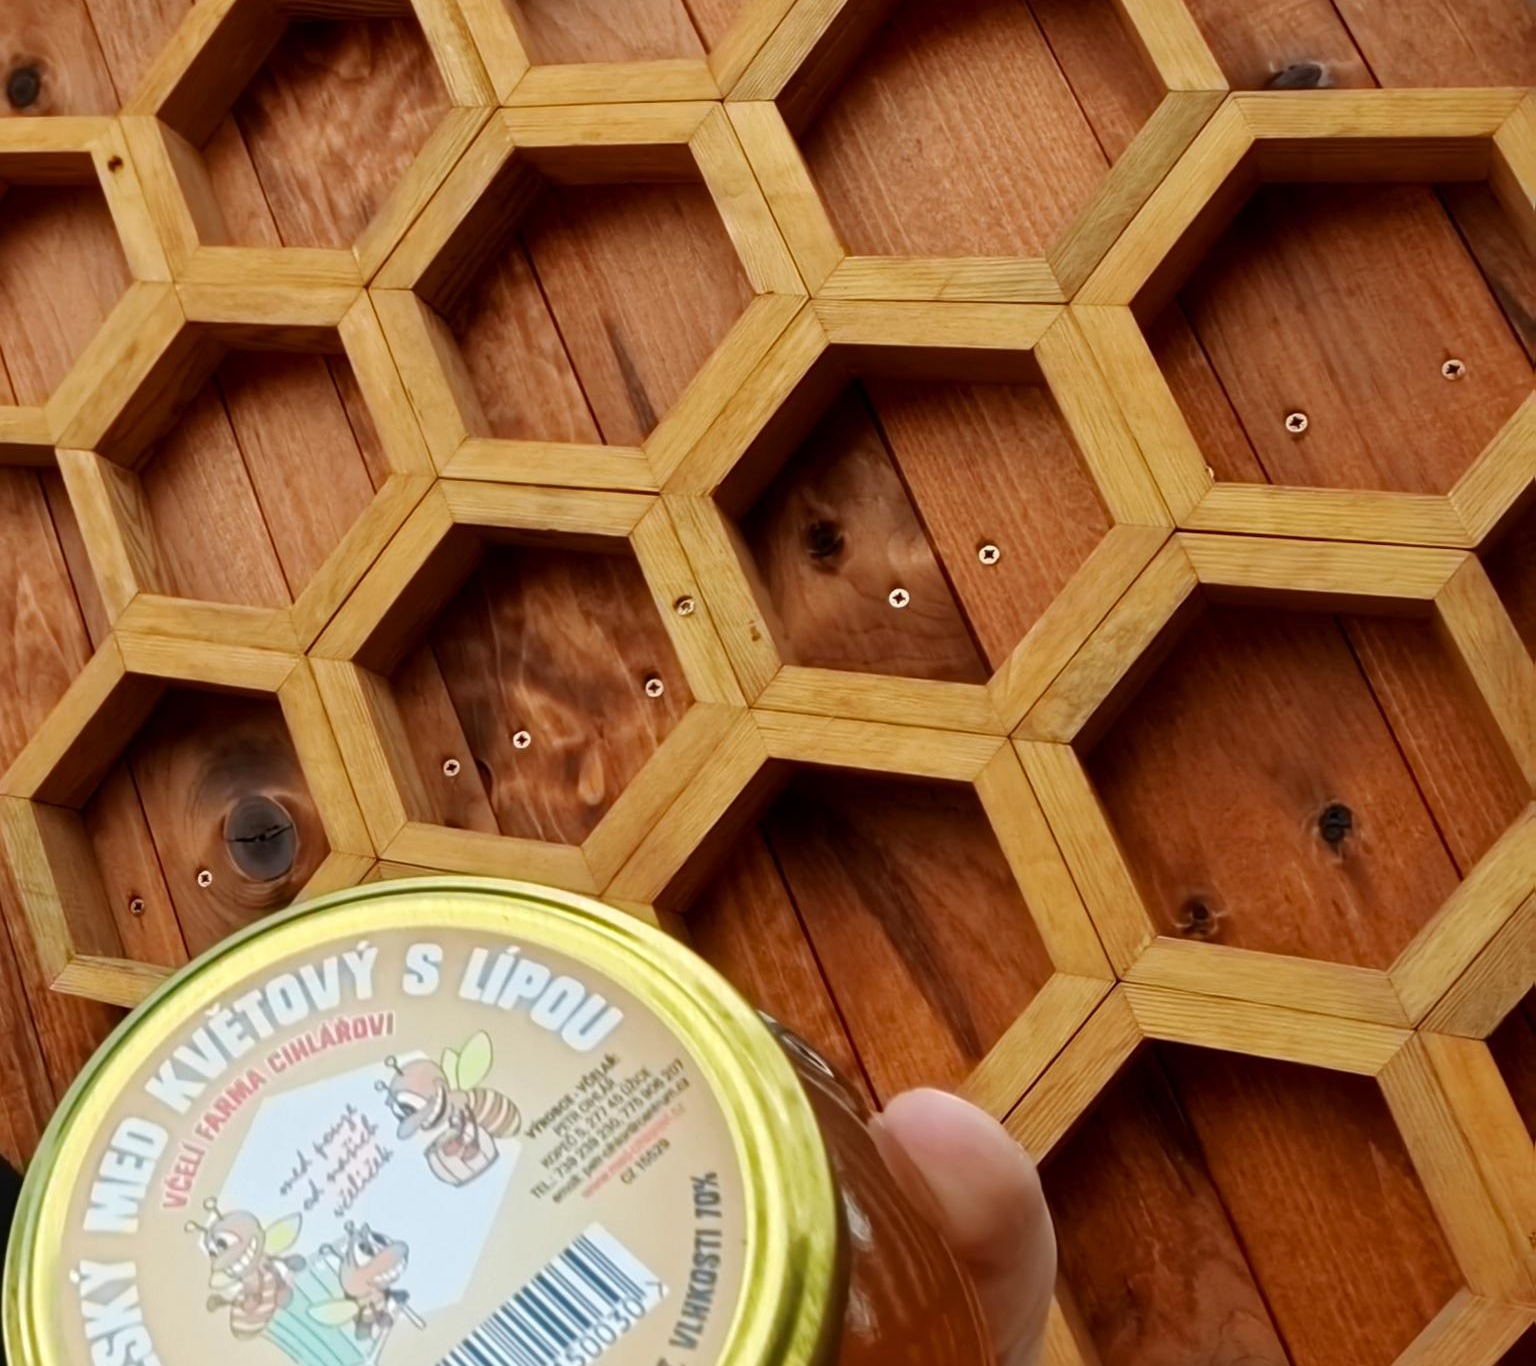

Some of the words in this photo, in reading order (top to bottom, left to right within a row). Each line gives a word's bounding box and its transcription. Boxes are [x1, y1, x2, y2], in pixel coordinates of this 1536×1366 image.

[83, 1117, 168, 1234] MED
[144, 939, 379, 1115] KVĚTOVÝ
[403, 943, 443, 995] S
[459, 946, 624, 1052] LÍPOU
[163, 1141, 205, 1211] VČELÍ
[195, 1069, 267, 1143] FARMA
[267, 1011, 396, 1076] CIHLÁŘOVI
[668, 1229, 722, 1351] VLHKOSTI
